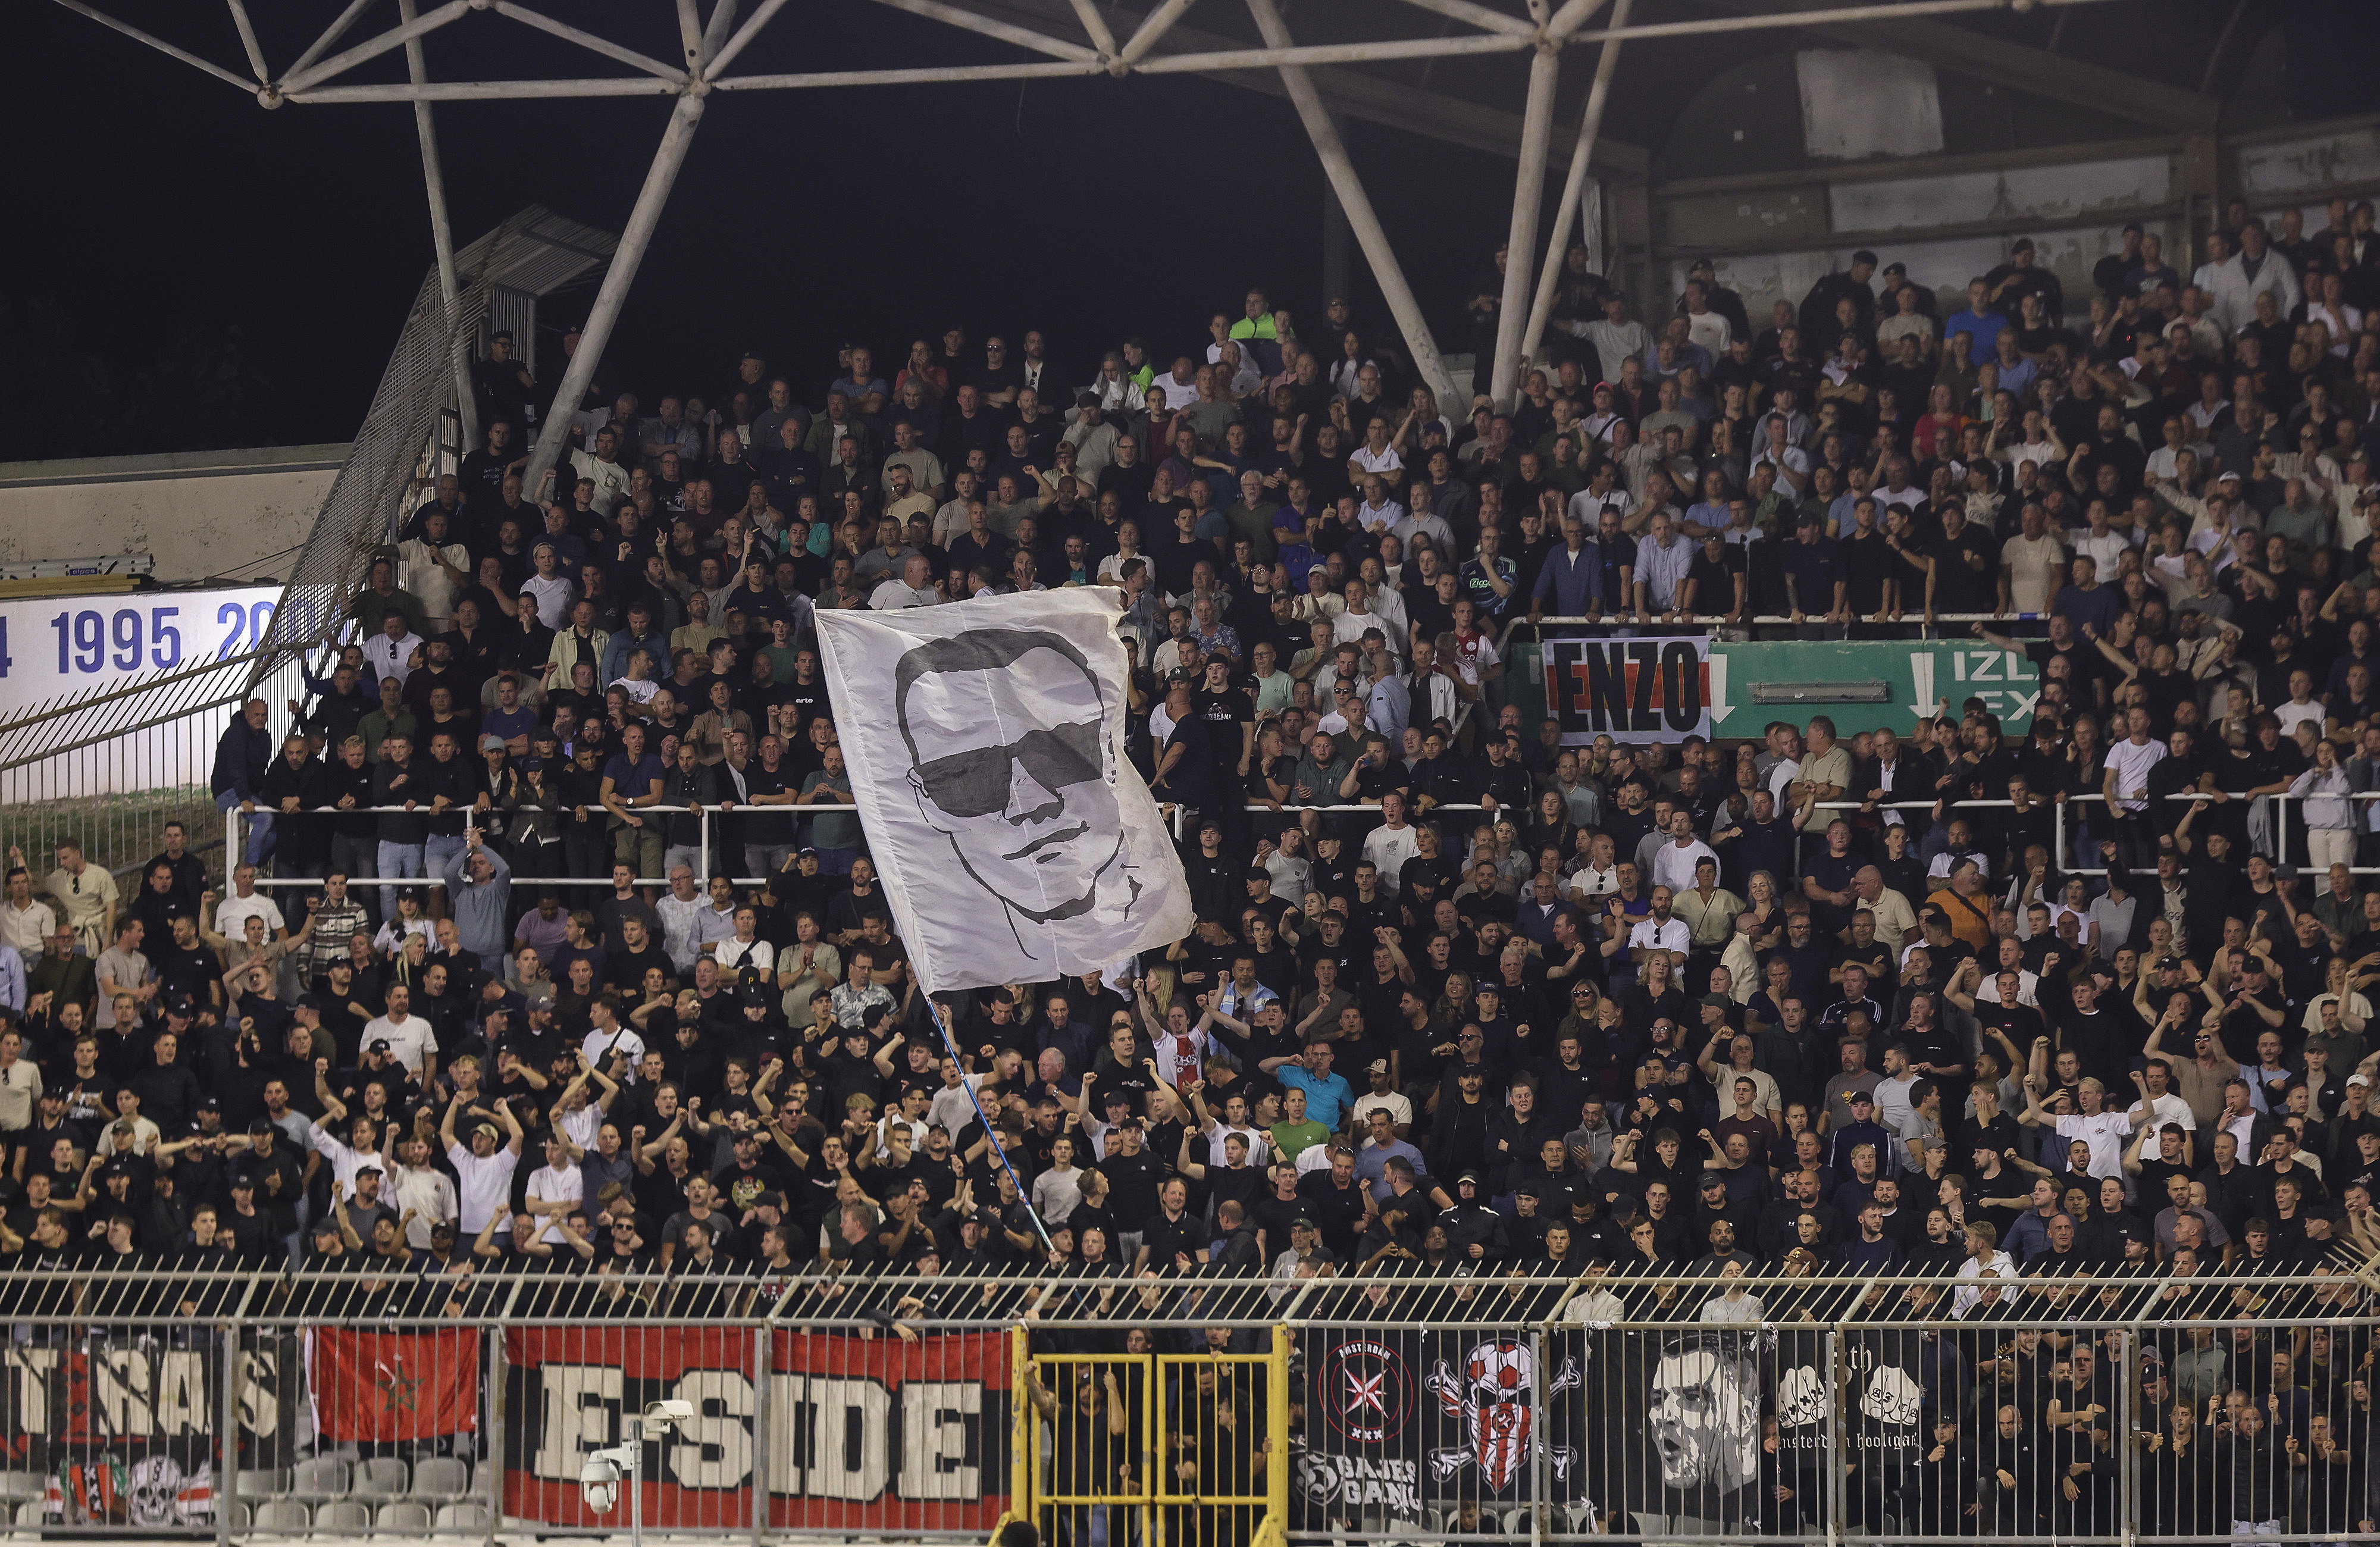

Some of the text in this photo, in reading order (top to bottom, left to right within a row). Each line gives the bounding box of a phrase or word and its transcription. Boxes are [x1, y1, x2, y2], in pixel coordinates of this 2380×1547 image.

[51, 607, 181, 674] 1995
[1954, 650, 2040, 681] IZL
[1553, 641, 1701, 732] ENZO
